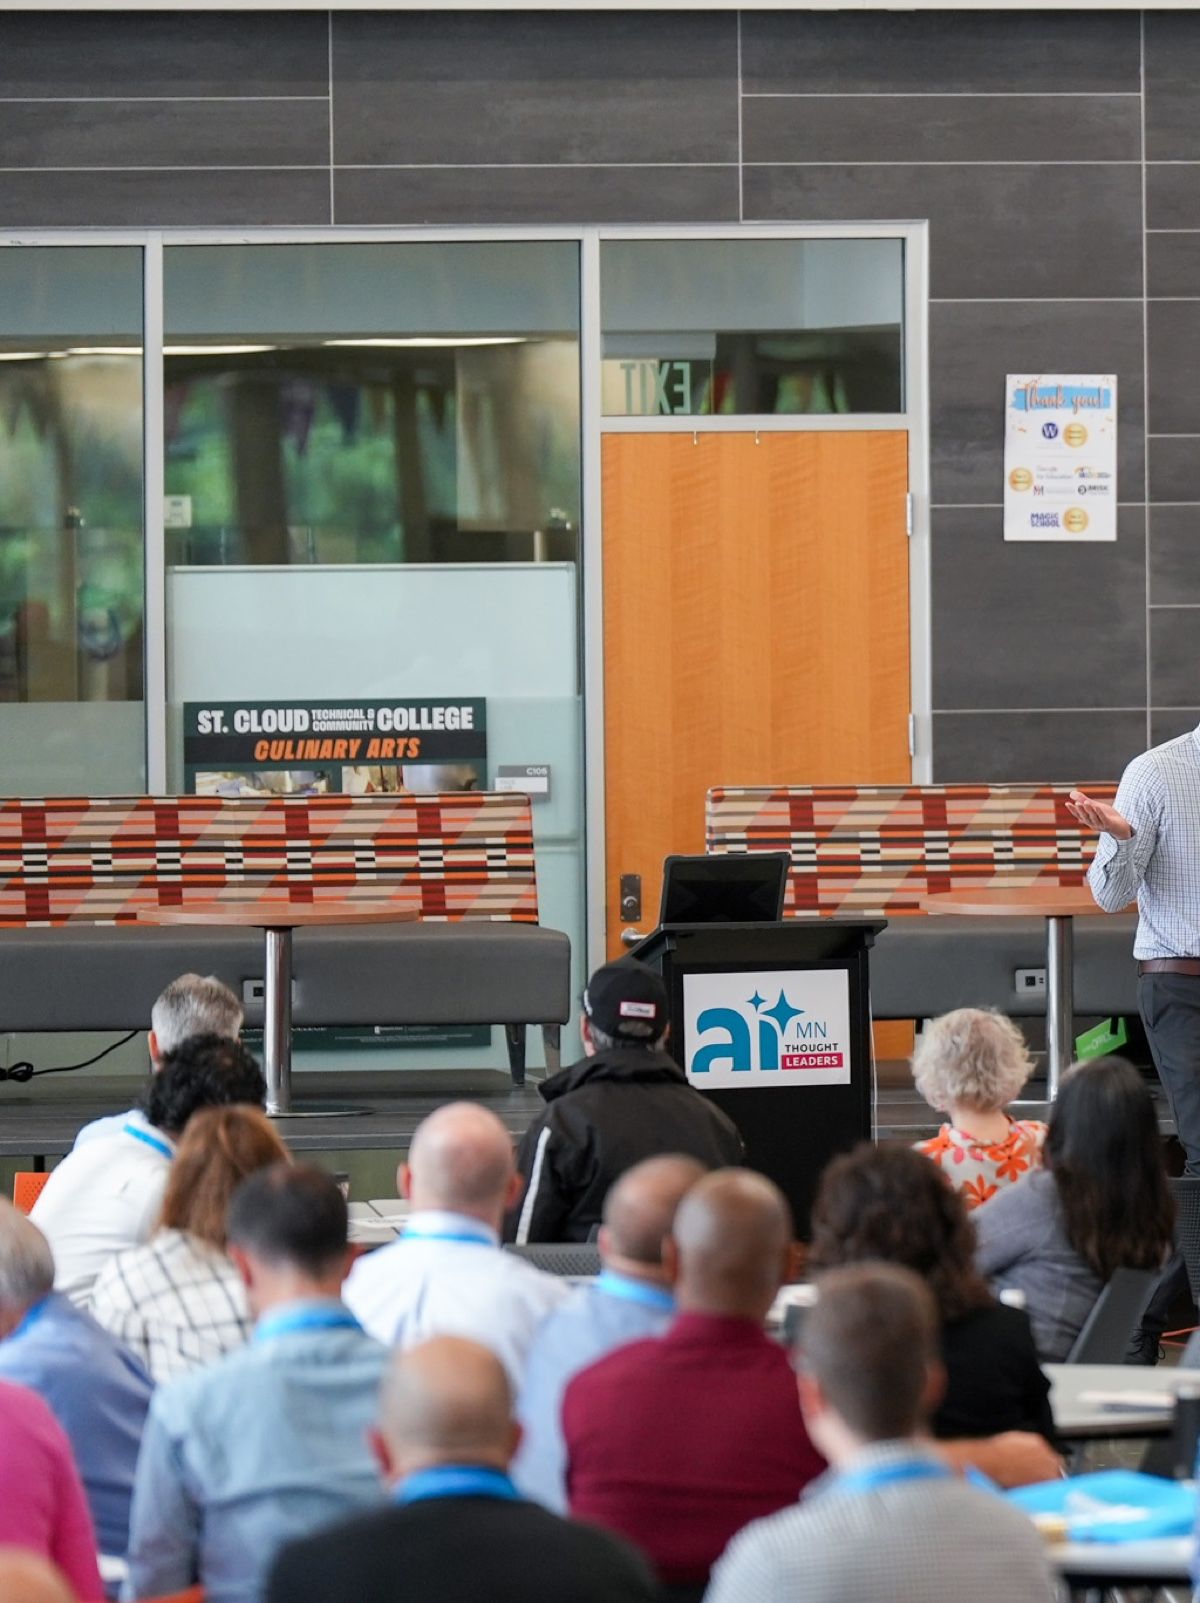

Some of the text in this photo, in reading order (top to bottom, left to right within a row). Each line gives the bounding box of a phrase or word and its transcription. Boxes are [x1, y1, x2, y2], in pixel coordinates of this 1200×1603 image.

[1017, 382, 1065, 412] Thank
[197, 709, 229, 734] ST.
[233, 708, 310, 733] CLOUD
[311, 709, 365, 720] TECHNICAL
[376, 706, 474, 731] COLLEGE
[312, 720, 374, 731] COMMUNITY
[254, 737, 421, 761] CULINARY ARTS
[691, 990, 827, 1073] ai MN
[785, 1043, 839, 1052] THOUGHT
[786, 1056, 838, 1067] LEADERS
